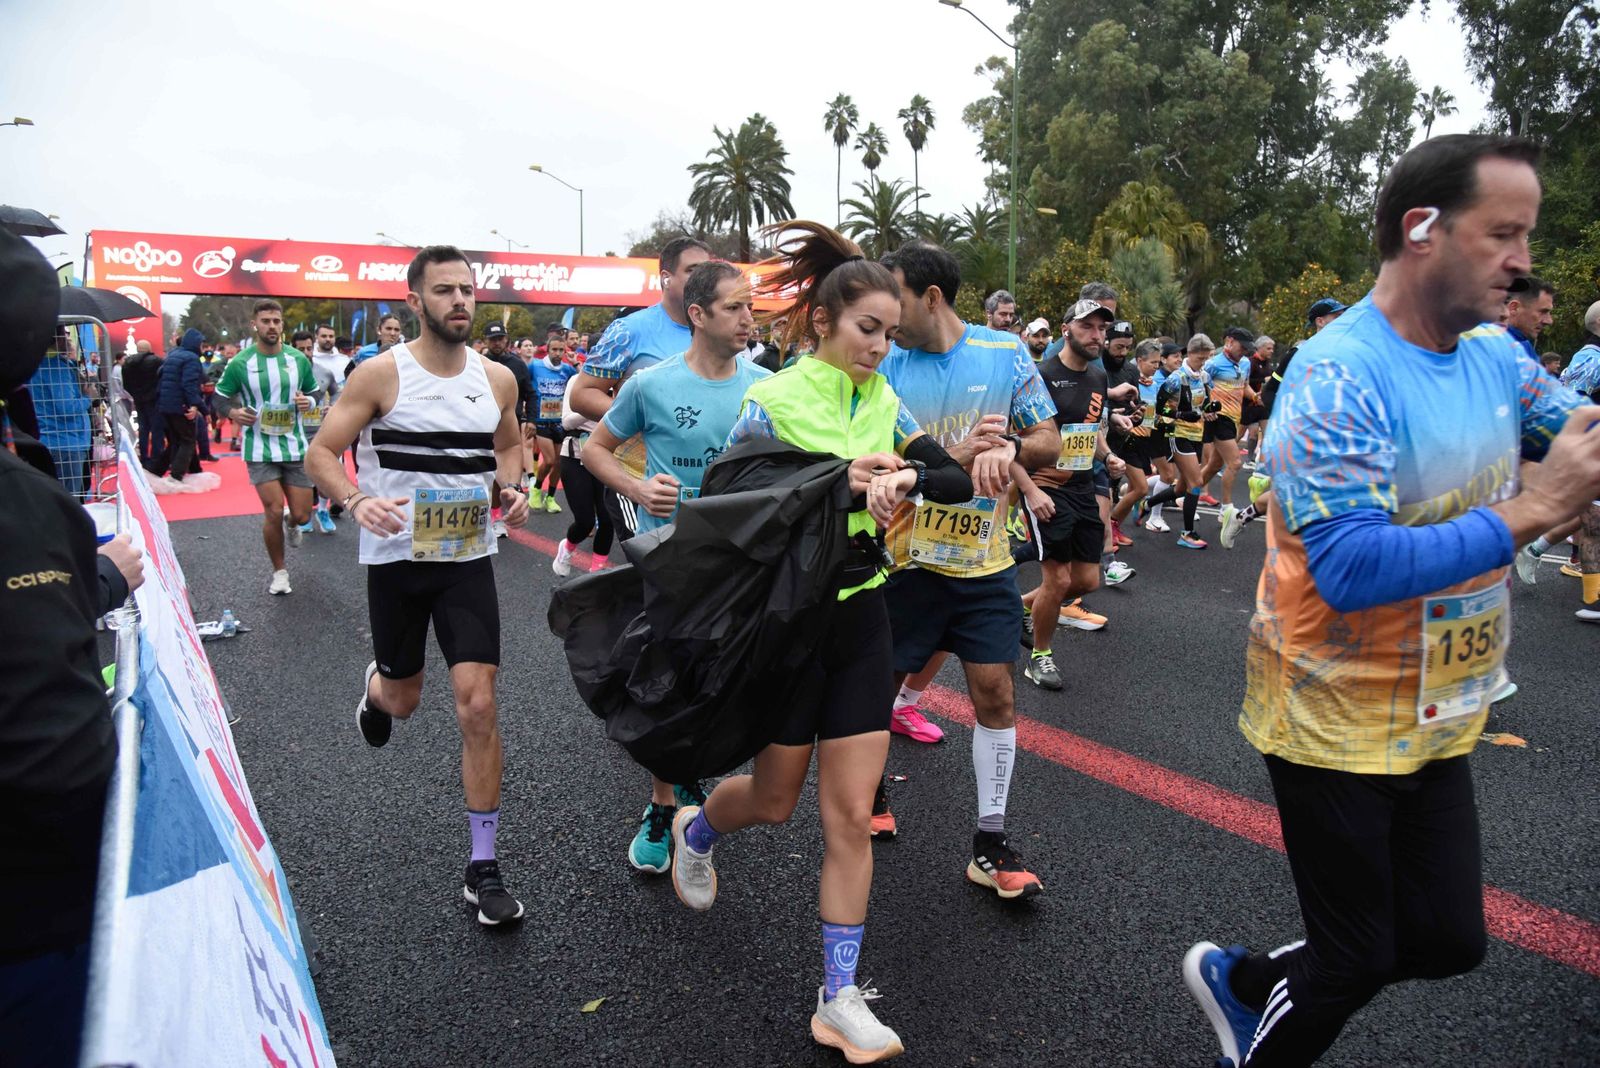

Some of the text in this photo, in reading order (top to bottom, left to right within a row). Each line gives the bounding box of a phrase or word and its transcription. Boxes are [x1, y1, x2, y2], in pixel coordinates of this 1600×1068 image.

[967, 384, 988, 393] HOKA
[1066, 435, 1095, 449] 13619
[672, 456, 703, 468] EBORA
[422, 505, 480, 529] 11478
[922, 506, 982, 537] 17193
[7, 574, 37, 589] CCI
[990, 743, 1013, 807] kalenji
